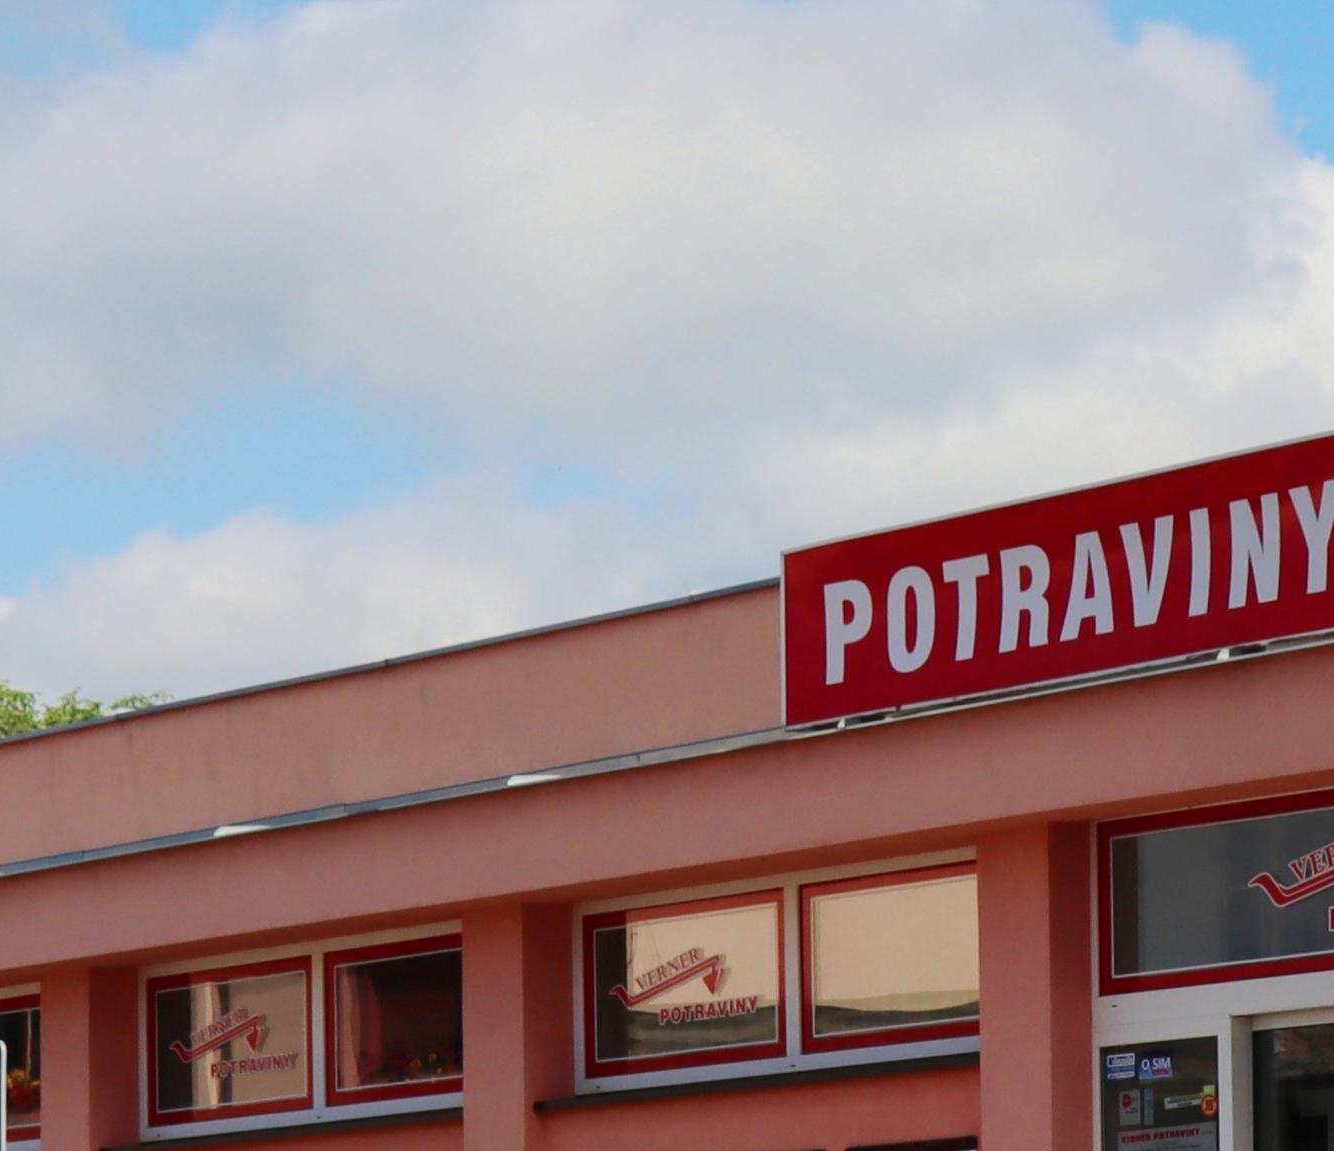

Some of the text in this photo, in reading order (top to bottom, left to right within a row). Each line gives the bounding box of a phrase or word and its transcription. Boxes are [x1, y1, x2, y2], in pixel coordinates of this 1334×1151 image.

[635, 947, 702, 989] VERNER
[659, 996, 759, 1025] POTRAVINY
[210, 1053, 298, 1079] POTRAVINY
[1152, 1057, 1171, 1070] SIM
